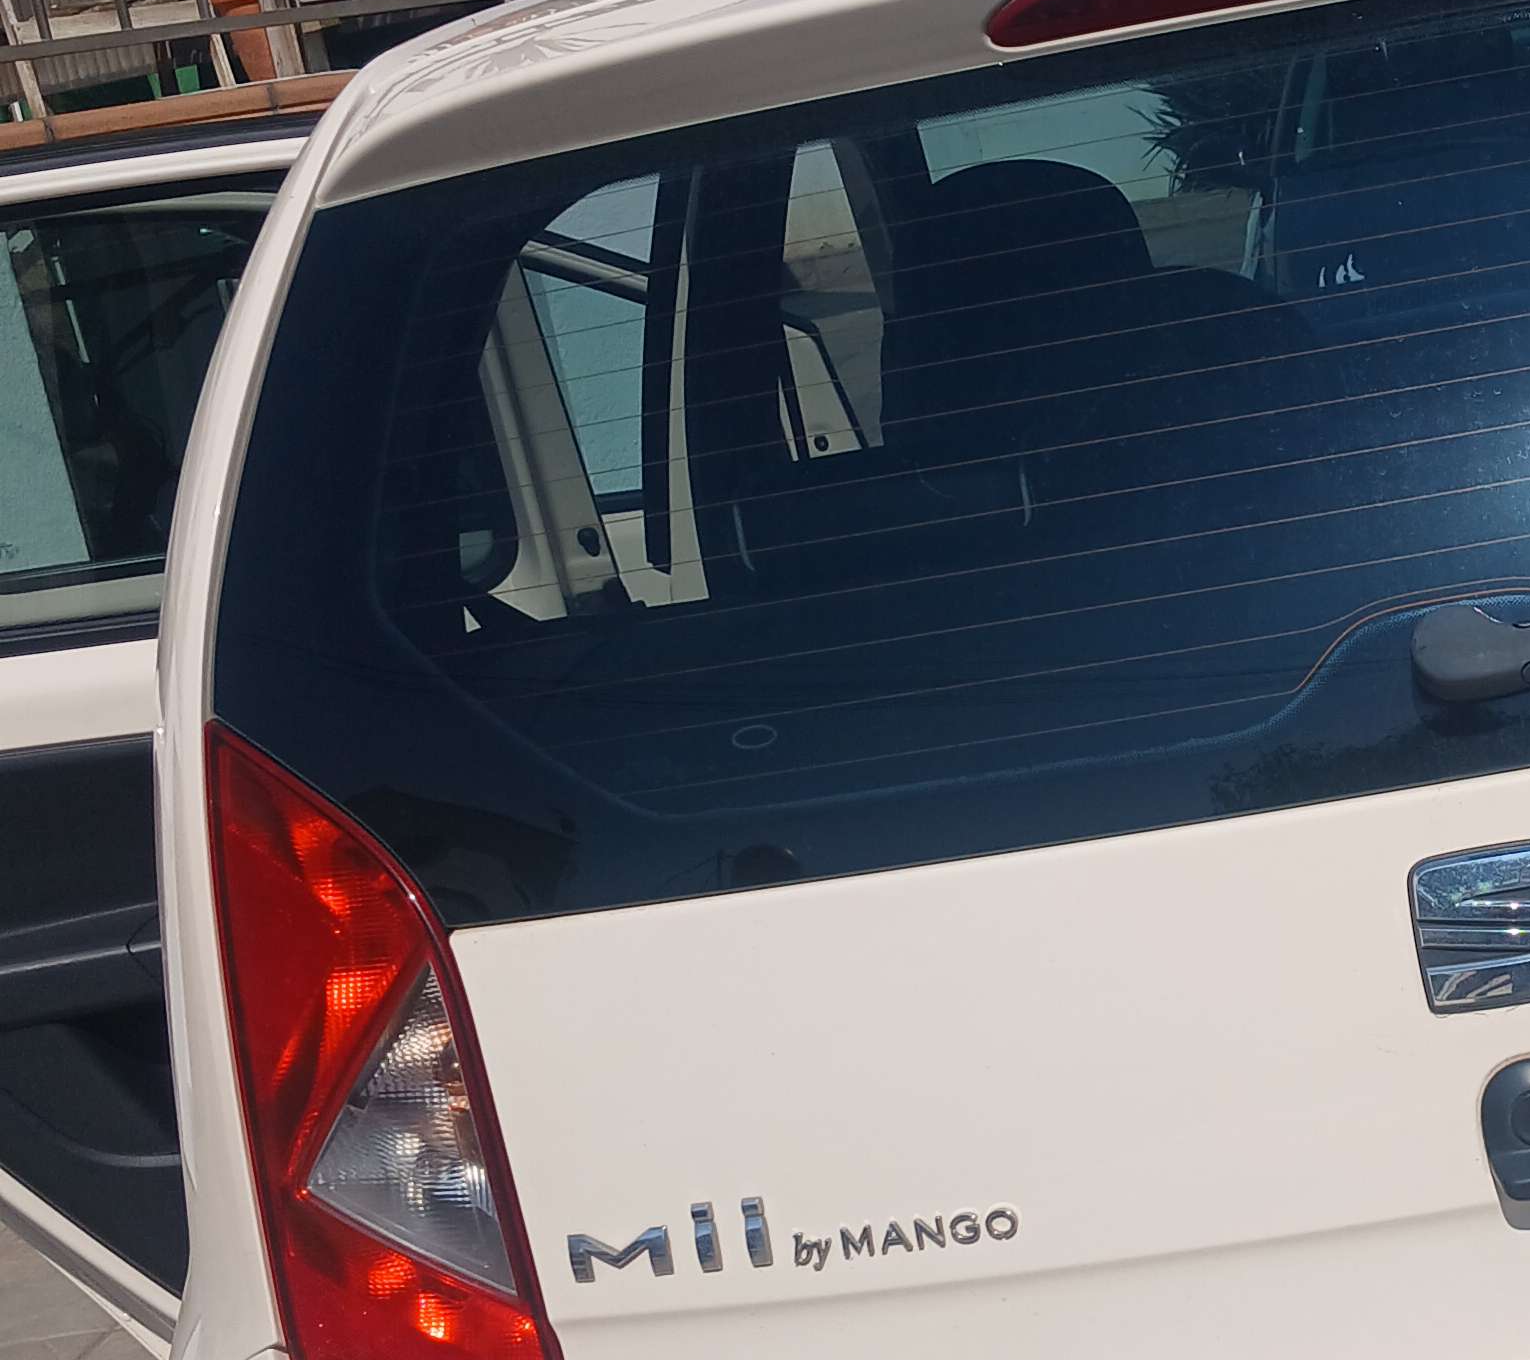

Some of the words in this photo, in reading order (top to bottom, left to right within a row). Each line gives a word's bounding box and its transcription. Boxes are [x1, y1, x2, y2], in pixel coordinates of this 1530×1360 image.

[567, 1196, 774, 1283] Mii
[793, 1231, 832, 1272] by
[839, 1207, 1018, 1261] MANGO
